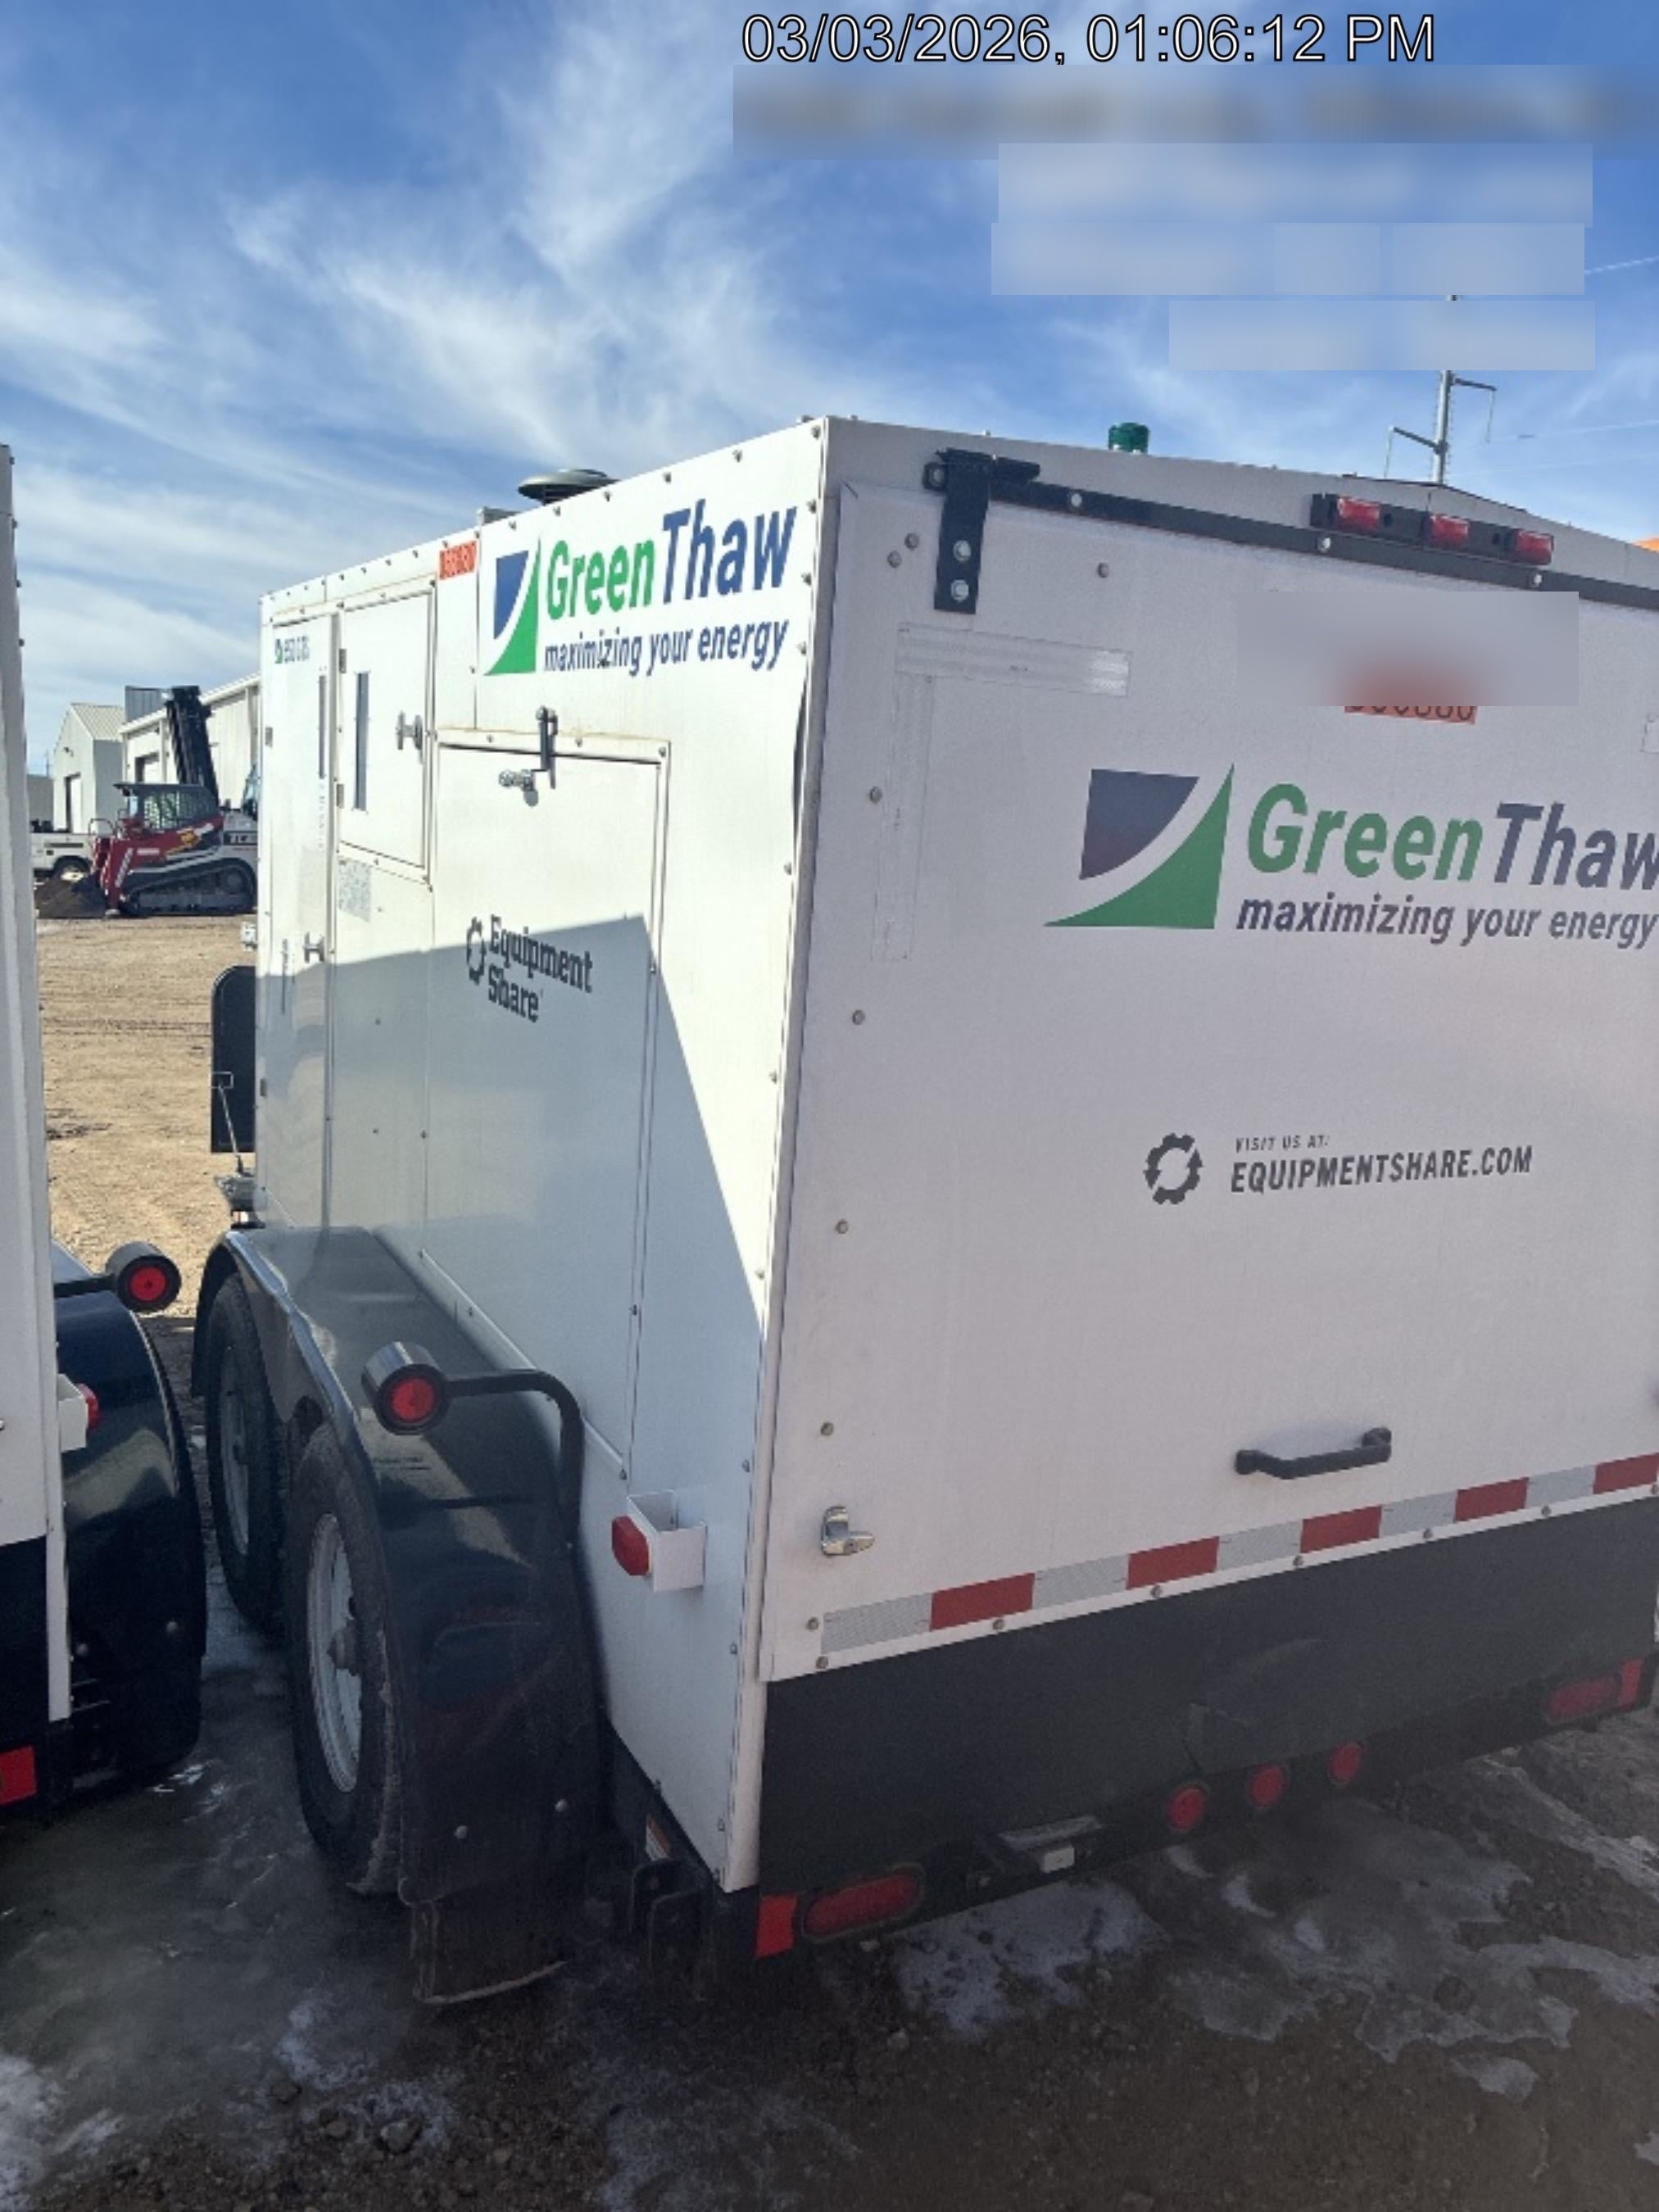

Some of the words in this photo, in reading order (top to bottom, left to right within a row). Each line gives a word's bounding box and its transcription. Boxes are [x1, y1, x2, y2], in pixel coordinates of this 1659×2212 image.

[543, 627, 642, 677] maximizing
[646, 628, 694, 677] your
[698, 619, 789, 671] energy
[1235, 891, 1455, 945] maximizing
[1459, 908, 1542, 947] your
[1548, 910, 1659, 950] energy
[489, 913, 593, 994] Equipment
[488, 963, 539, 1023] Share
[1231, 1145, 1533, 1194] EQUIPMENTSHARE.COM
[1235, 1136, 1276, 1154] VISIT
[1282, 1134, 1301, 1150] US
